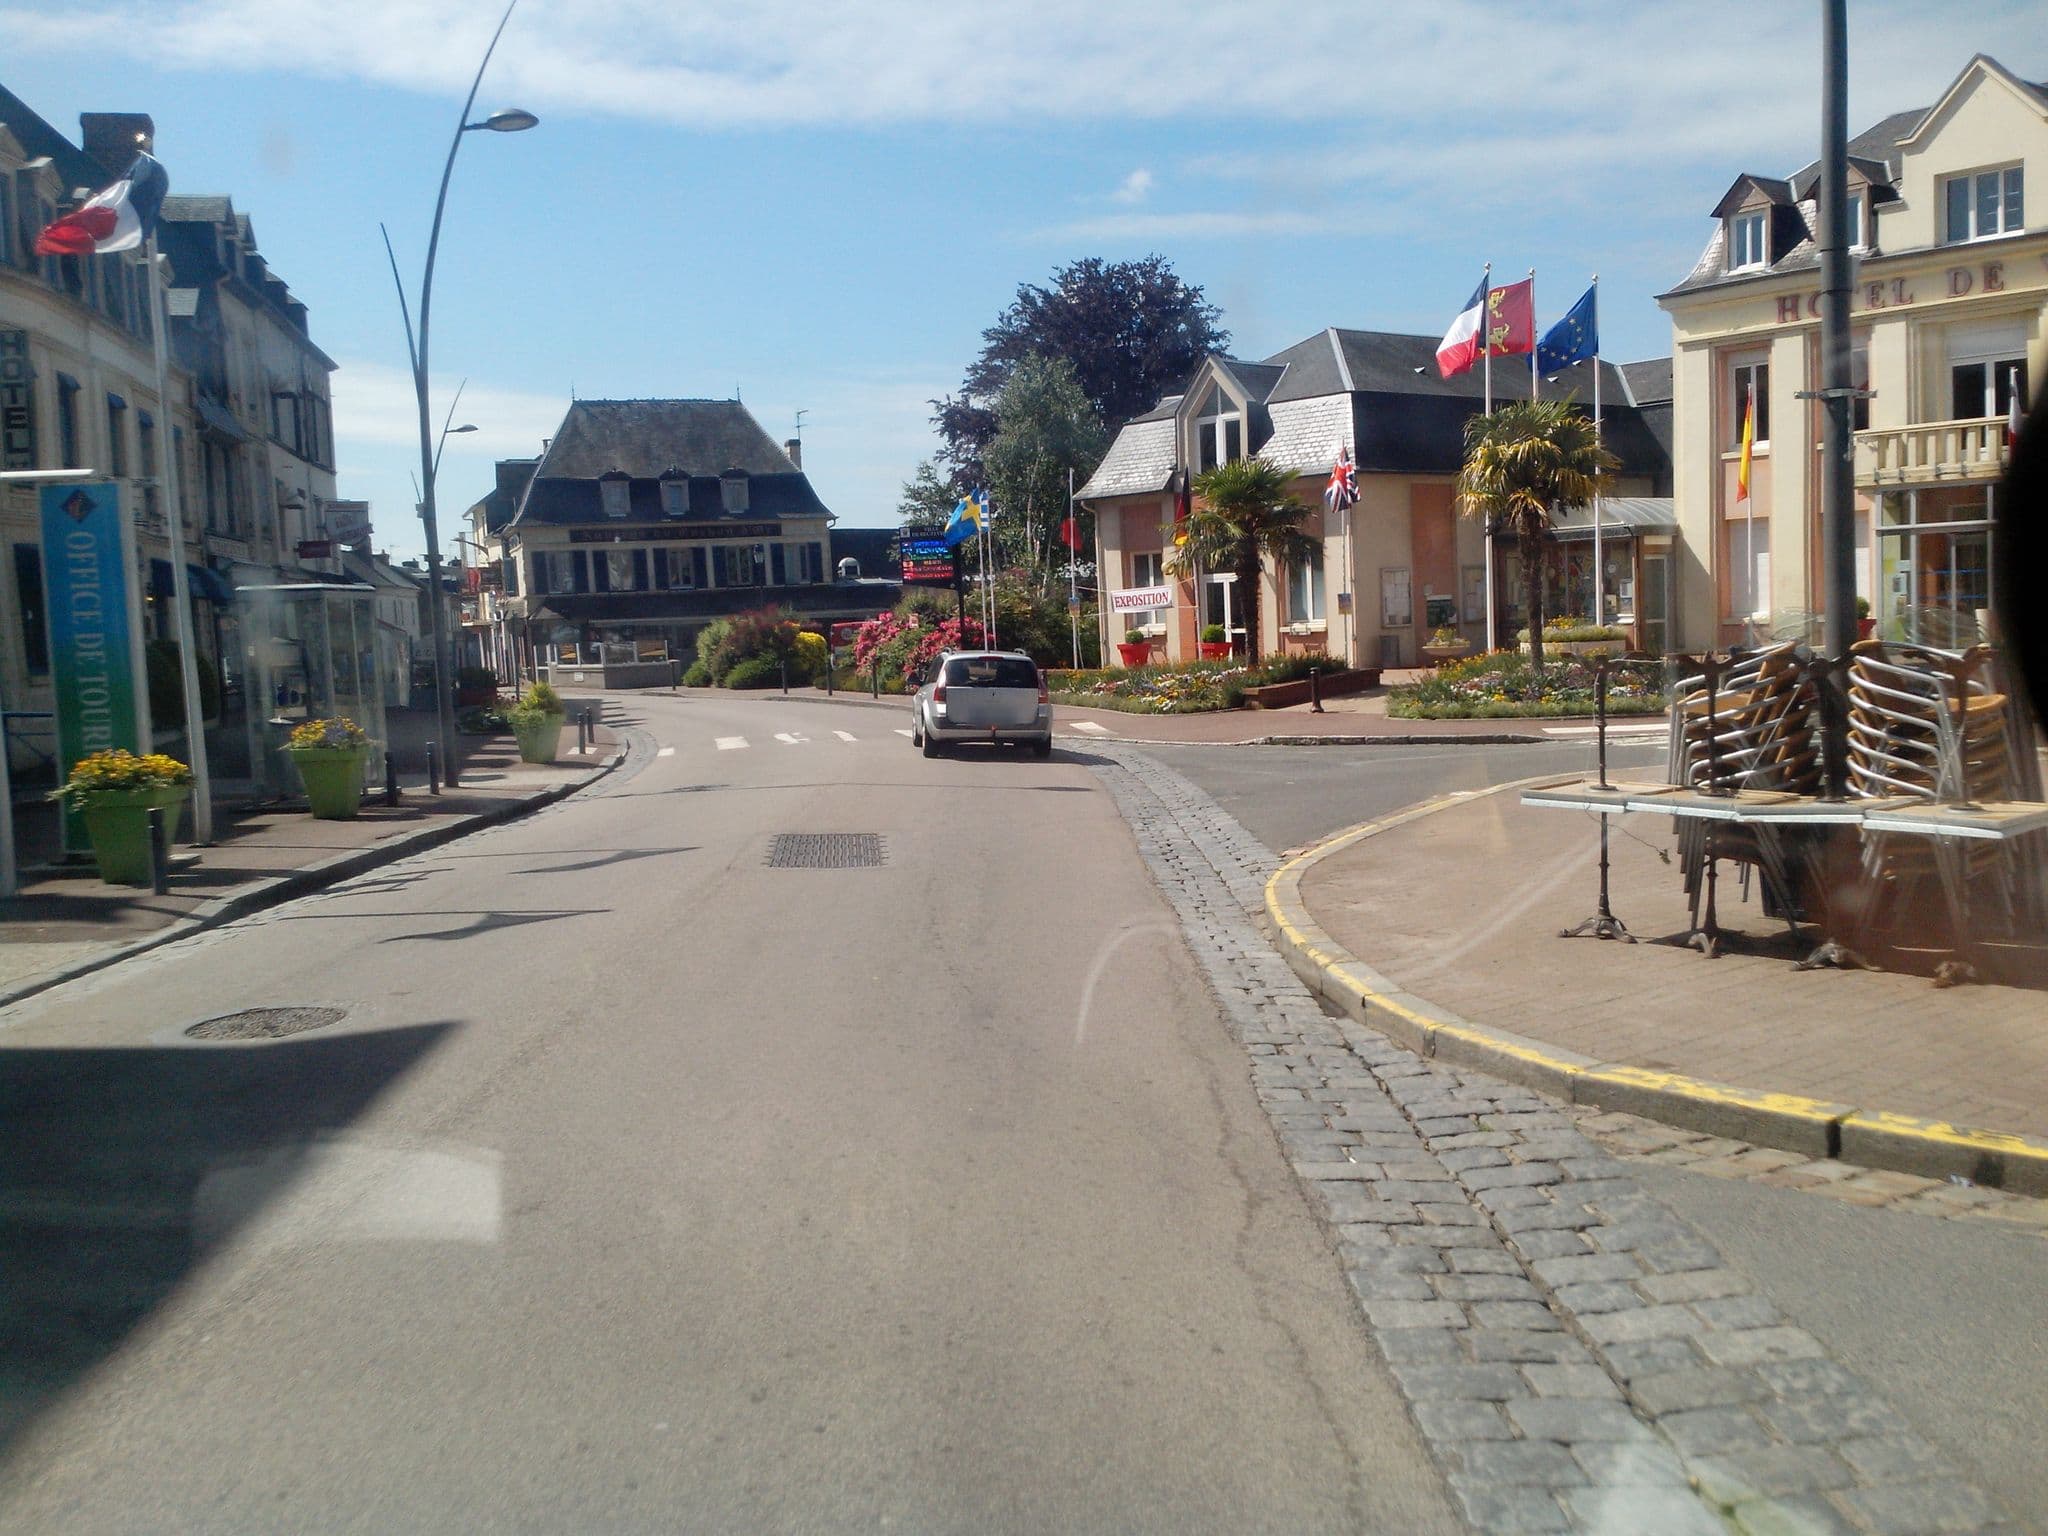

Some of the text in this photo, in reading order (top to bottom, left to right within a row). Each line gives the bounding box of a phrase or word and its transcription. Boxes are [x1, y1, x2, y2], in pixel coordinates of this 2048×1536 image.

[1947, 261, 2005, 298] DE
[1115, 592, 1169, 608] EXPOSITION
[64, 531, 114, 756] OFFICE DE TOURI
